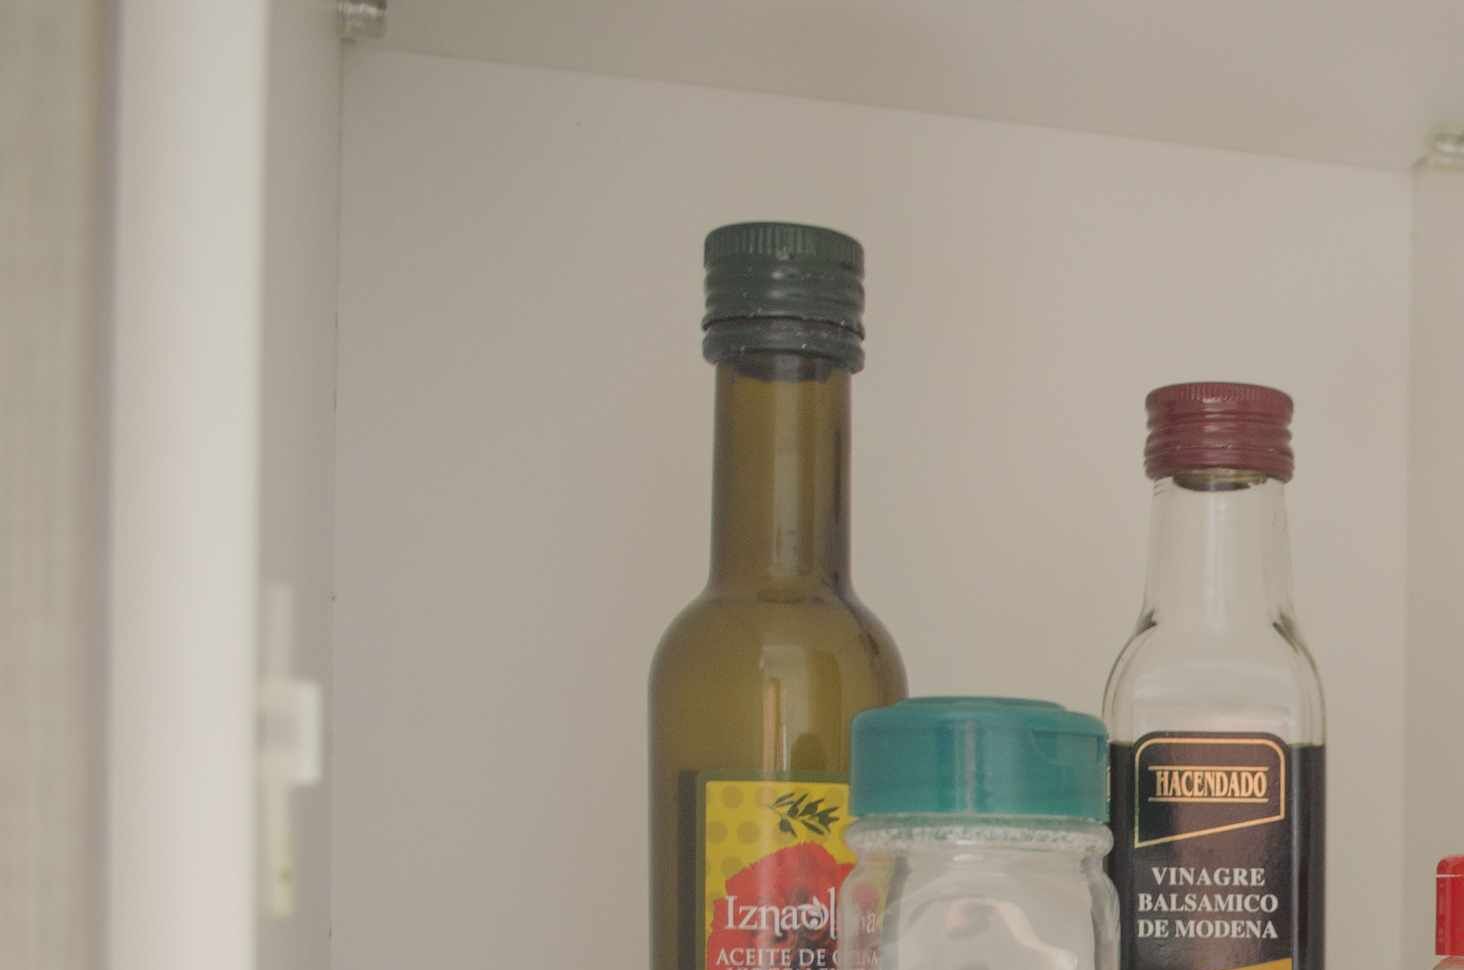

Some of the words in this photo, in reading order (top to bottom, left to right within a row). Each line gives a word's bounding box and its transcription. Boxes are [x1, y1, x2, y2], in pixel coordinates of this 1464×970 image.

[1155, 771, 1268, 798] HACENDADO
[1151, 867, 1266, 887] VINAGRE
[1137, 893, 1279, 914] BALSAMICO
[1137, 919, 1169, 939] DE
[1174, 919, 1279, 939] MODENA
[716, 948, 792, 967] ACEITE
[799, 948, 826, 967] DE
